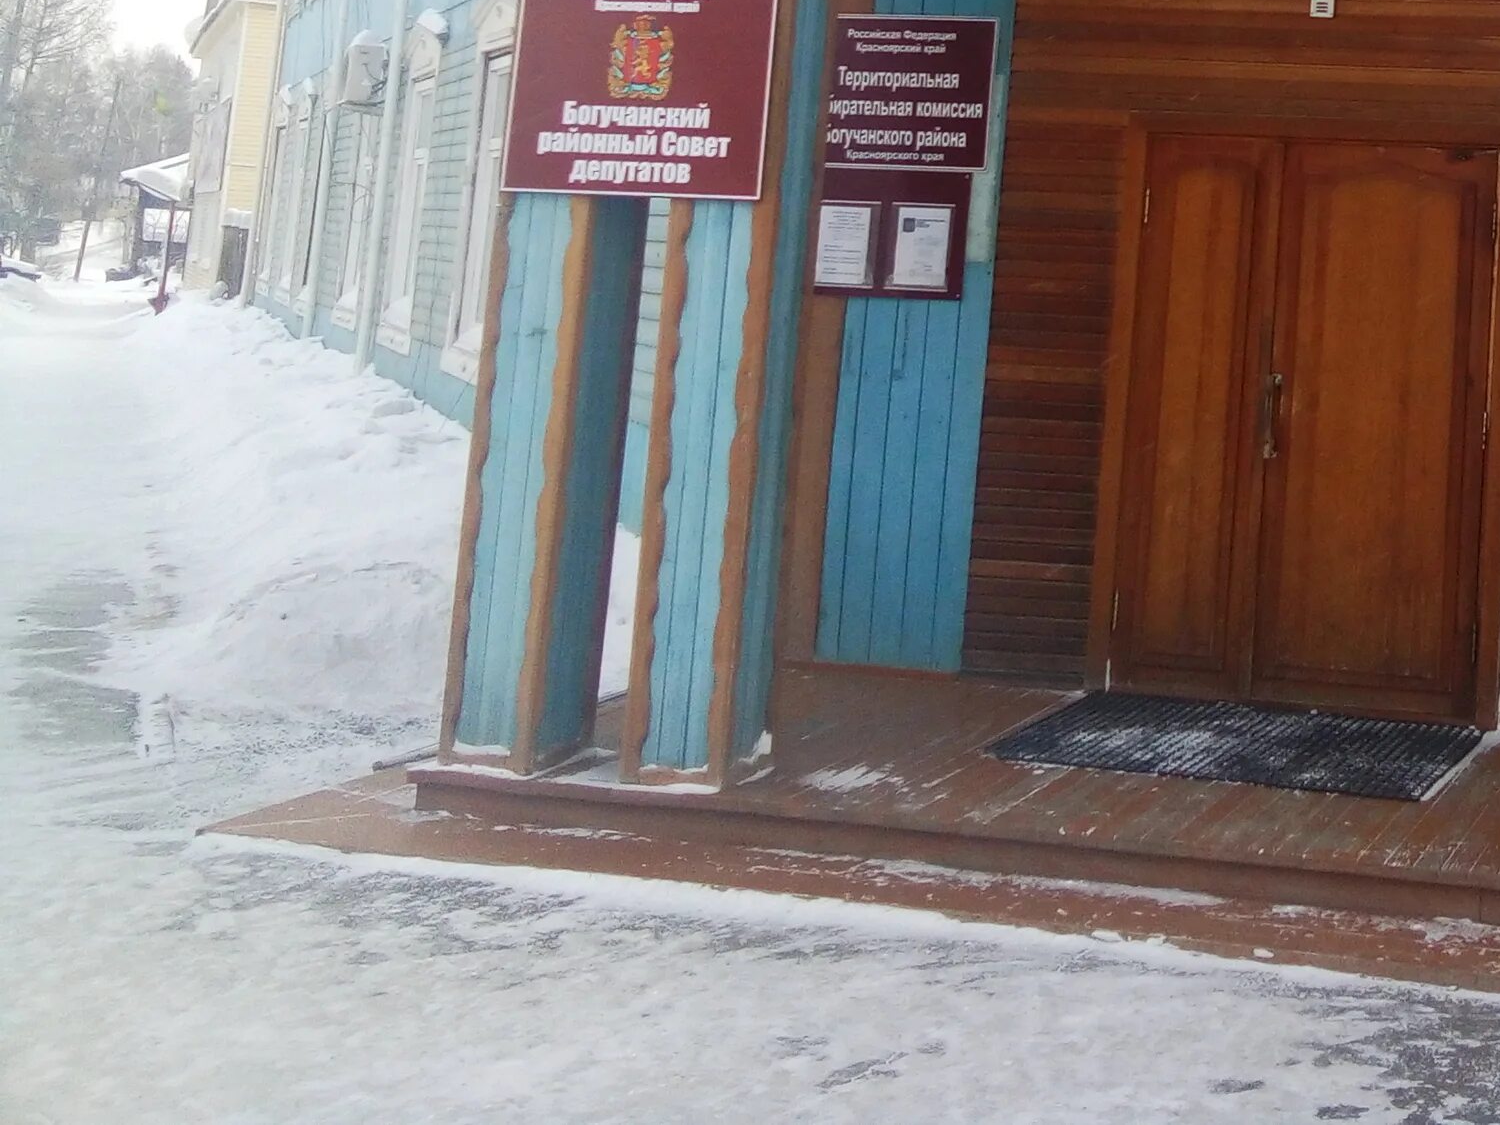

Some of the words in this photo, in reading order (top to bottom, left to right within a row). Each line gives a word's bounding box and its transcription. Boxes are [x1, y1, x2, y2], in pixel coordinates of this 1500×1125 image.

[847, 28, 901, 40] Российская
[903, 29, 957, 41] Федерация
[855, 41, 922, 55] Красноярский
[923, 43, 947, 55] край
[837, 65, 960, 92] Территориальная
[562, 100, 711, 129] Богучанский
[915, 101, 983, 119] комиссия
[536, 127, 658, 155] районный
[661, 131, 732, 158] Совет
[915, 126, 967, 151] района
[846, 149, 920, 161] Красноярского
[920, 152, 945, 162] края
[568, 159, 692, 184] депутатов
